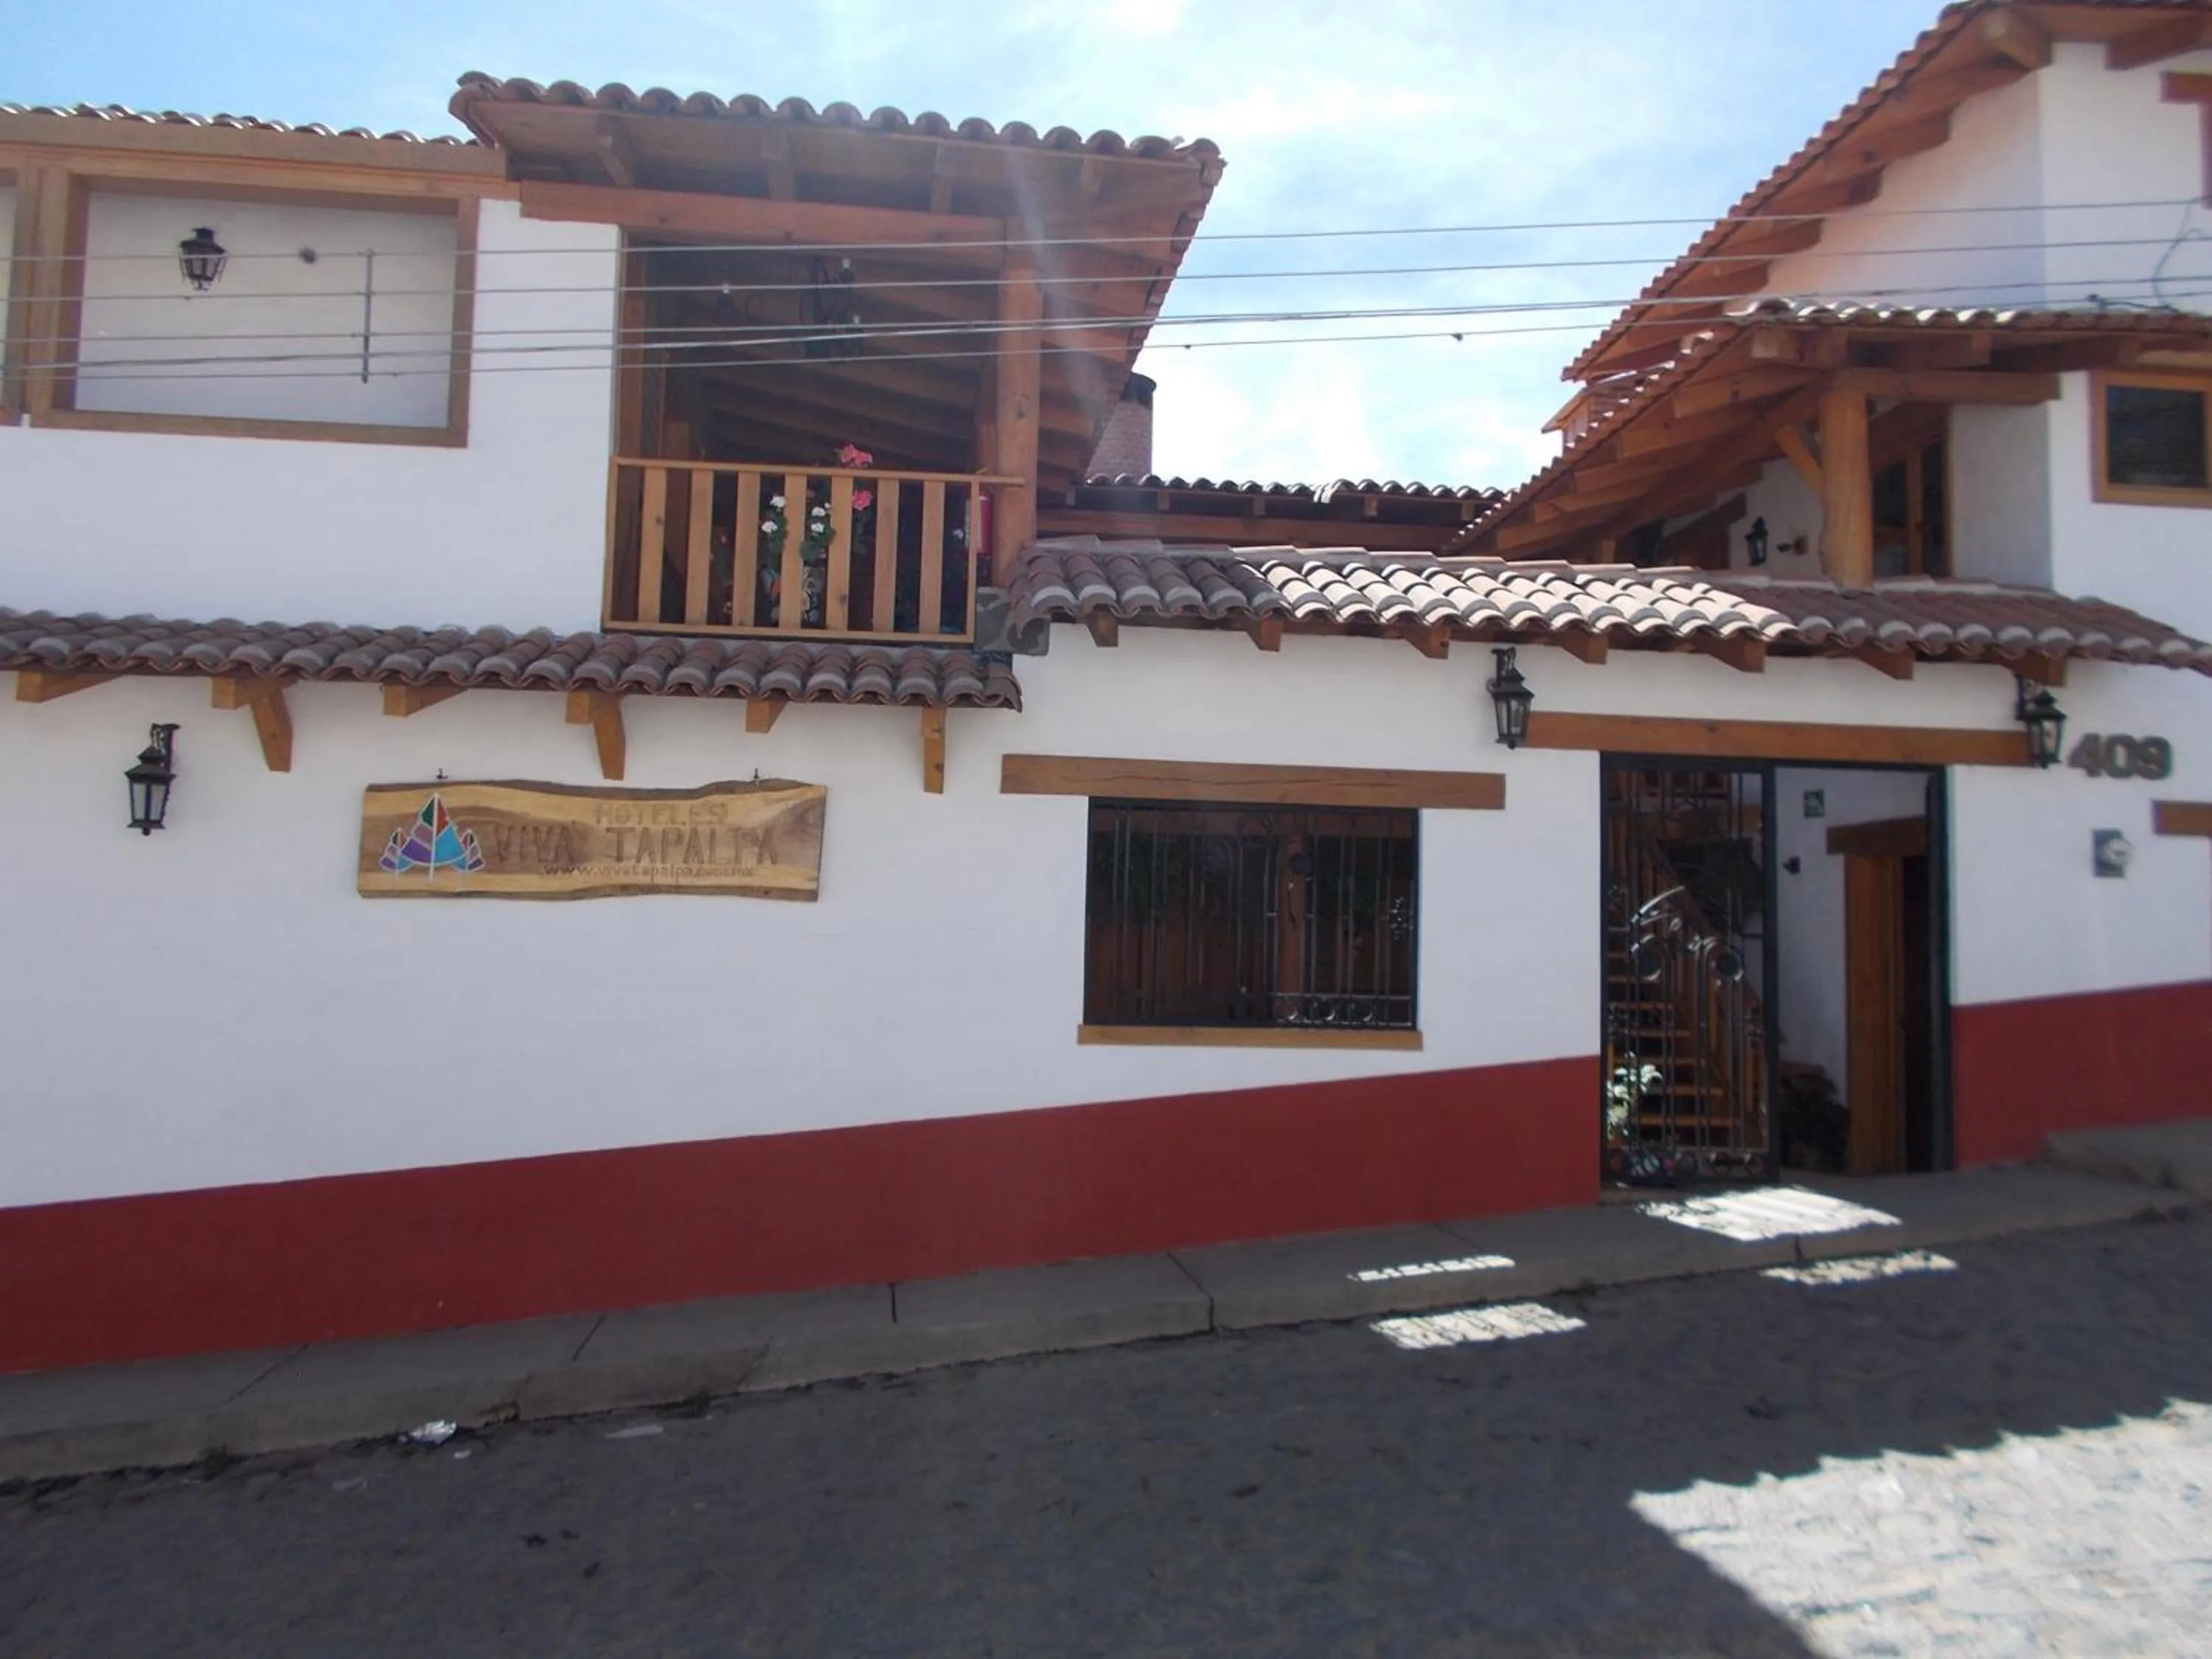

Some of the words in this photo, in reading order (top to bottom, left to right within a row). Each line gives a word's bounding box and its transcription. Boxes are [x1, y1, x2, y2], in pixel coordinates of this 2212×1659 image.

[2068, 733, 2172, 780] 409
[595, 801, 729, 826] HOTELES
[494, 824, 575, 865] VIVA
[605, 825, 779, 866] TAPALPA
